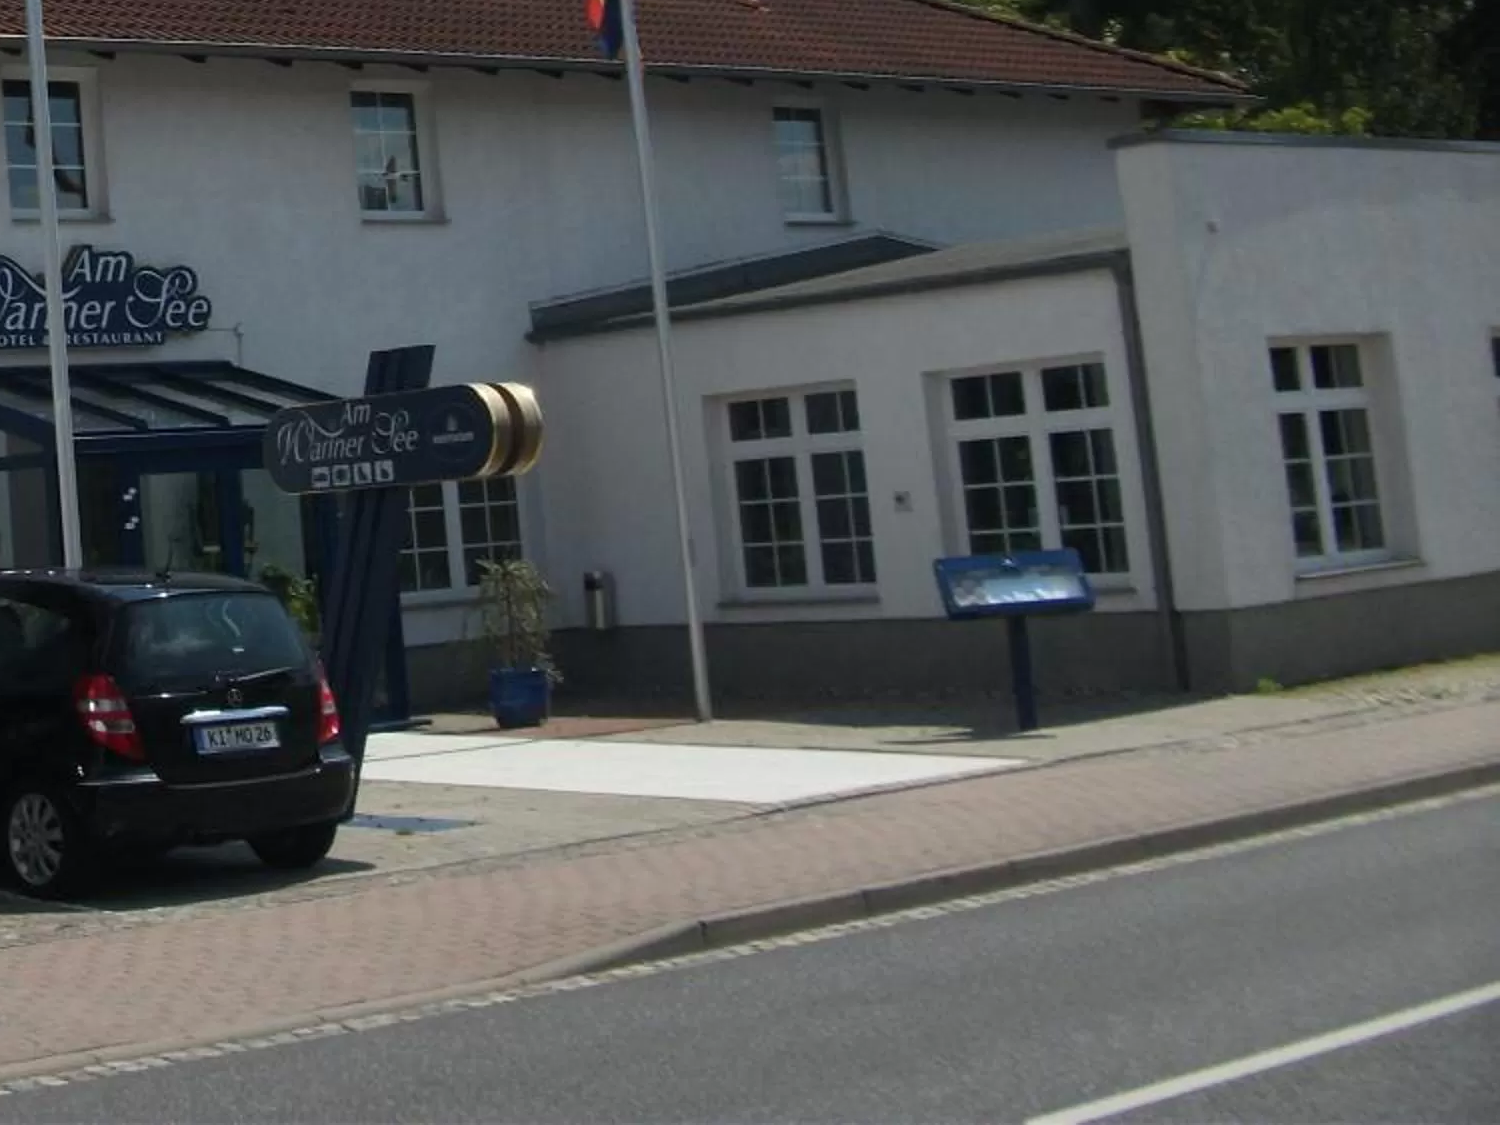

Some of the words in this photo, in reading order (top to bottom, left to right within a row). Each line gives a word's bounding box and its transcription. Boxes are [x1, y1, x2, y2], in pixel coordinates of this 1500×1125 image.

[69, 249, 128, 283] Am
[124, 269, 210, 329] See
[340, 402, 372, 426] Am
[371, 410, 420, 455] See
[206, 730, 228, 748] KI
